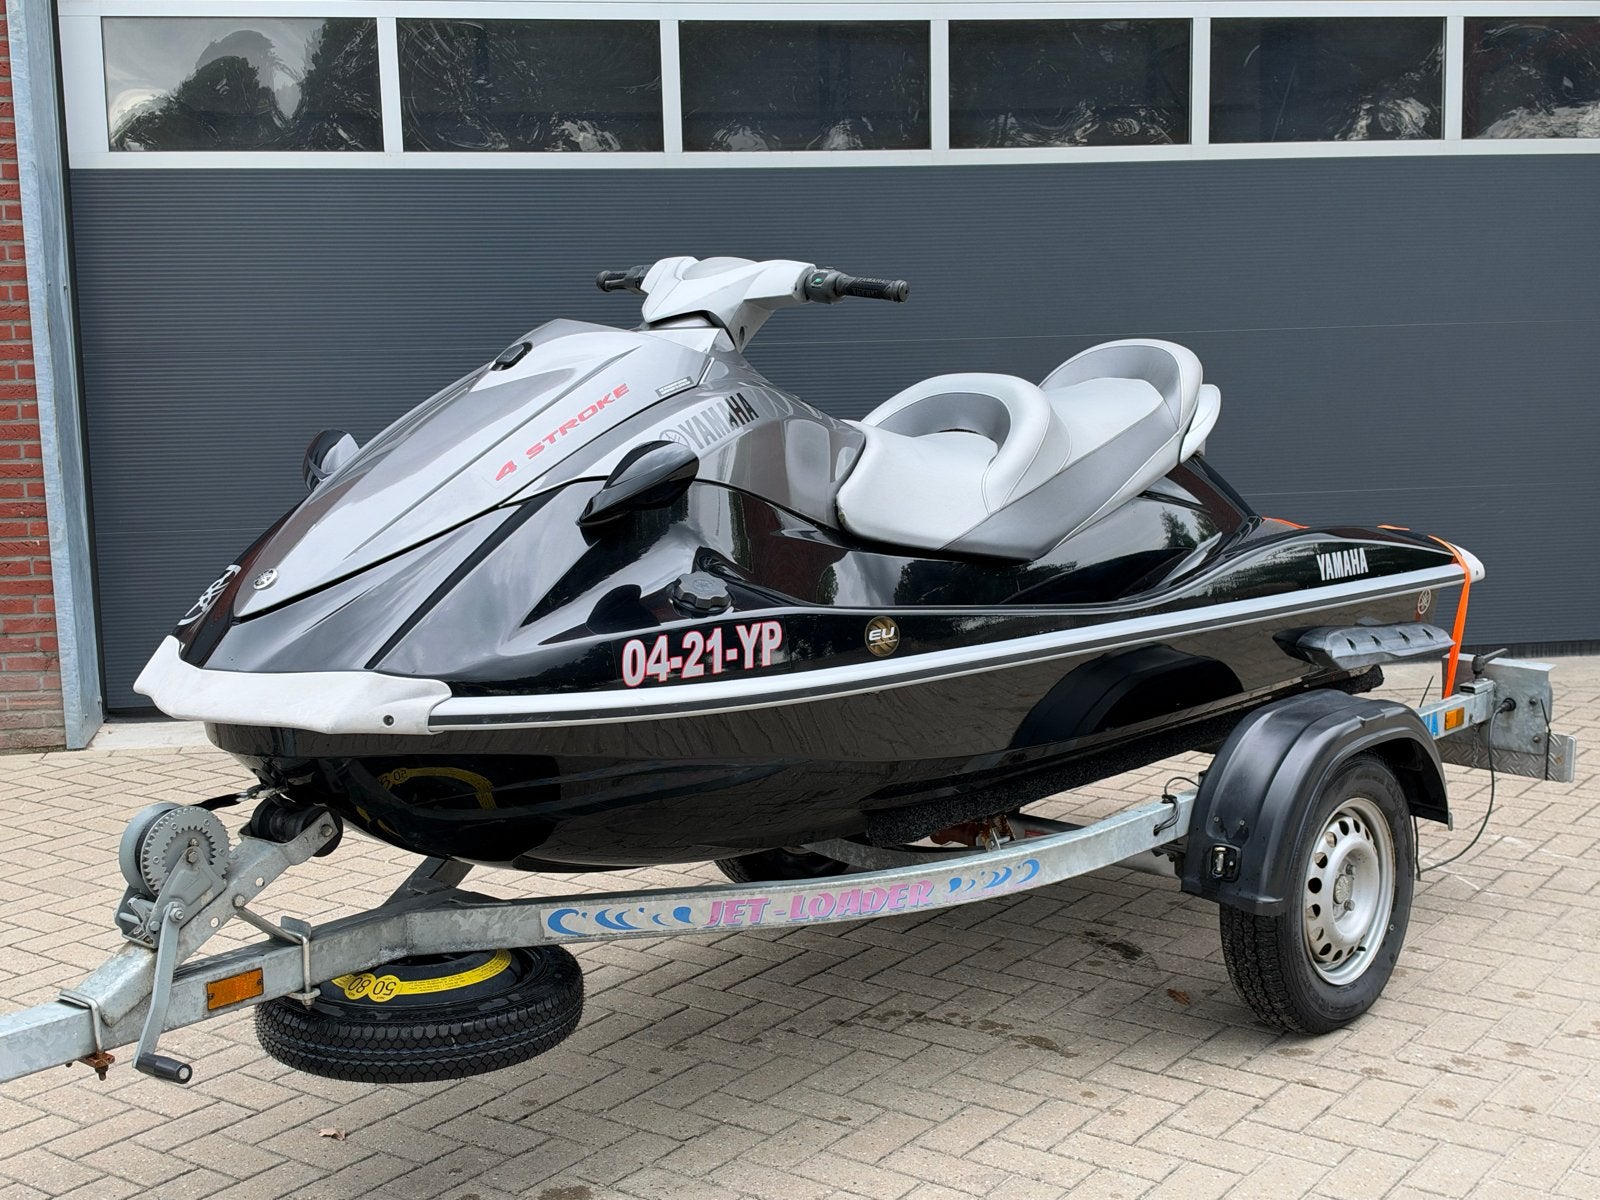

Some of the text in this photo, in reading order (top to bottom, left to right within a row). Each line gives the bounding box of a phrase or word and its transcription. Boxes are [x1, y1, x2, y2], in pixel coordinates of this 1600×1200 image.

[495, 383, 630, 482] 4 STROKE
[677, 392, 760, 450] YAMAHA
[1316, 547, 1369, 581] YAMAHA
[868, 626, 896, 641] EU
[622, 620, 783, 688] 04-21-YP
[347, 977, 372, 994] 80
[372, 980, 397, 996] 50
